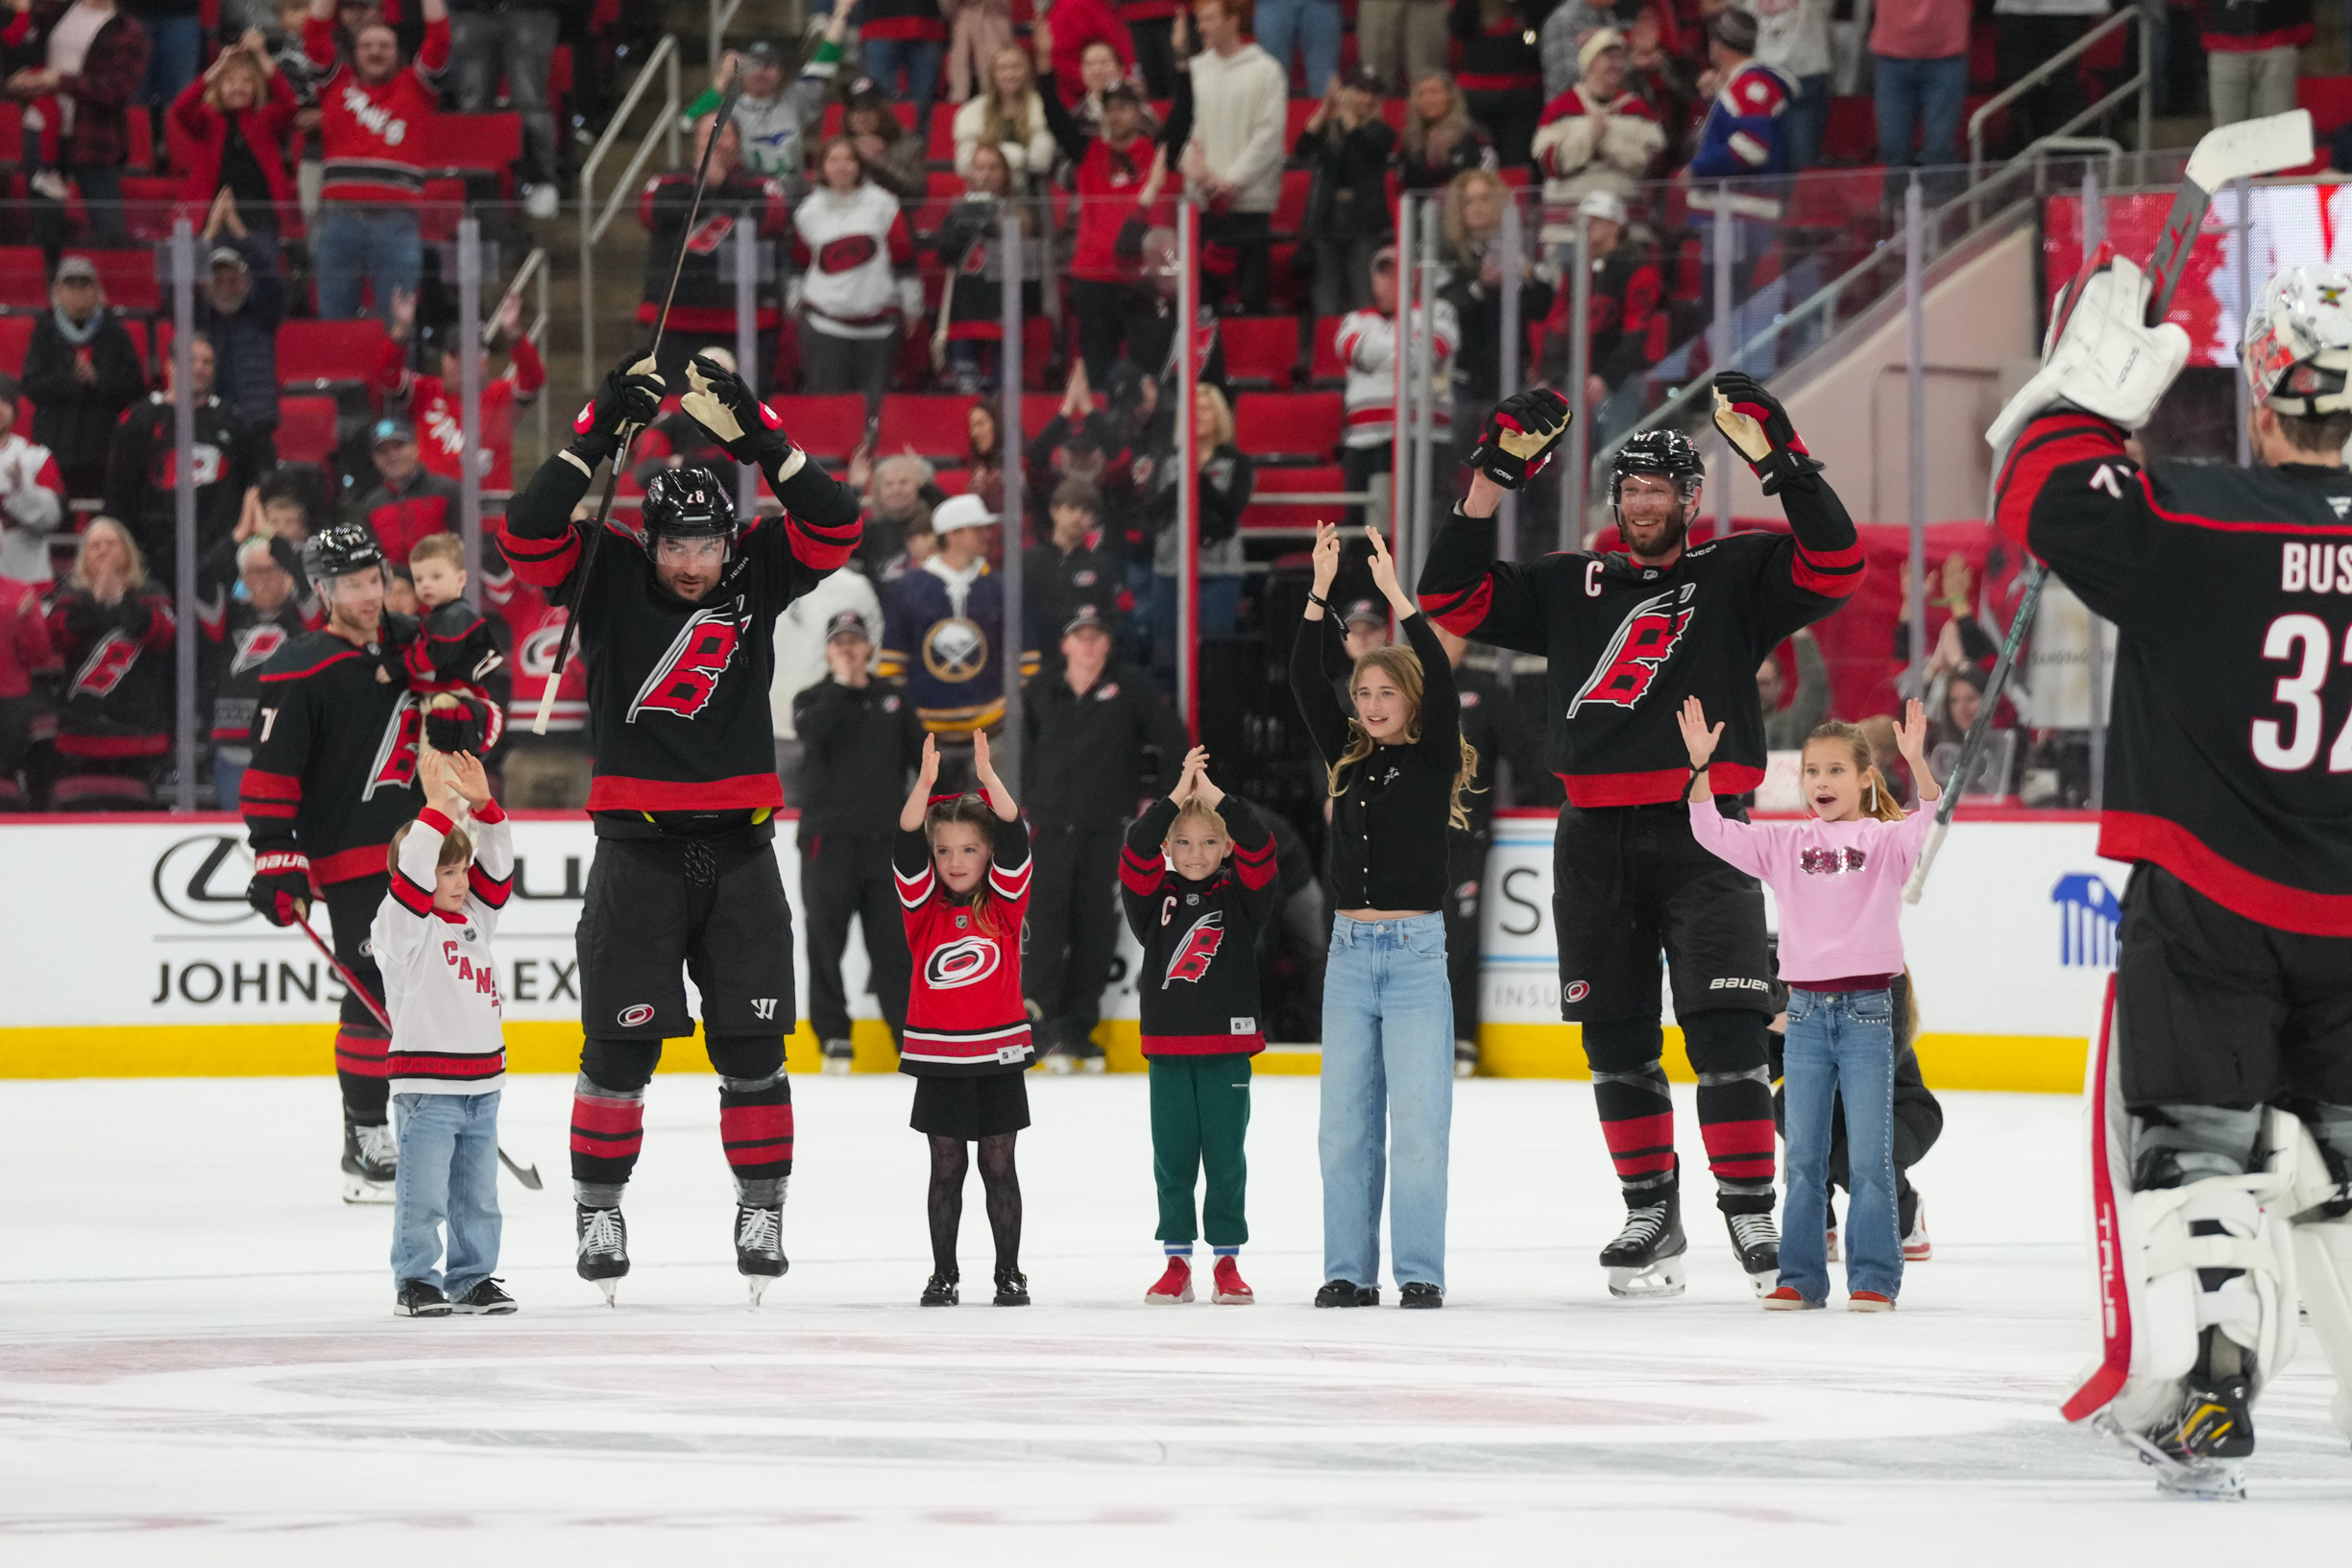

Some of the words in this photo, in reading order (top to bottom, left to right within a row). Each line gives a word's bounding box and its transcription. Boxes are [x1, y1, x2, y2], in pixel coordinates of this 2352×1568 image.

[1585, 560, 1605, 597] C
[1161, 896, 1177, 927] C
[151, 960, 349, 1003] JOHNS
[443, 940, 502, 1019] CAN
[2098, 1202, 2118, 1339] TRUE
